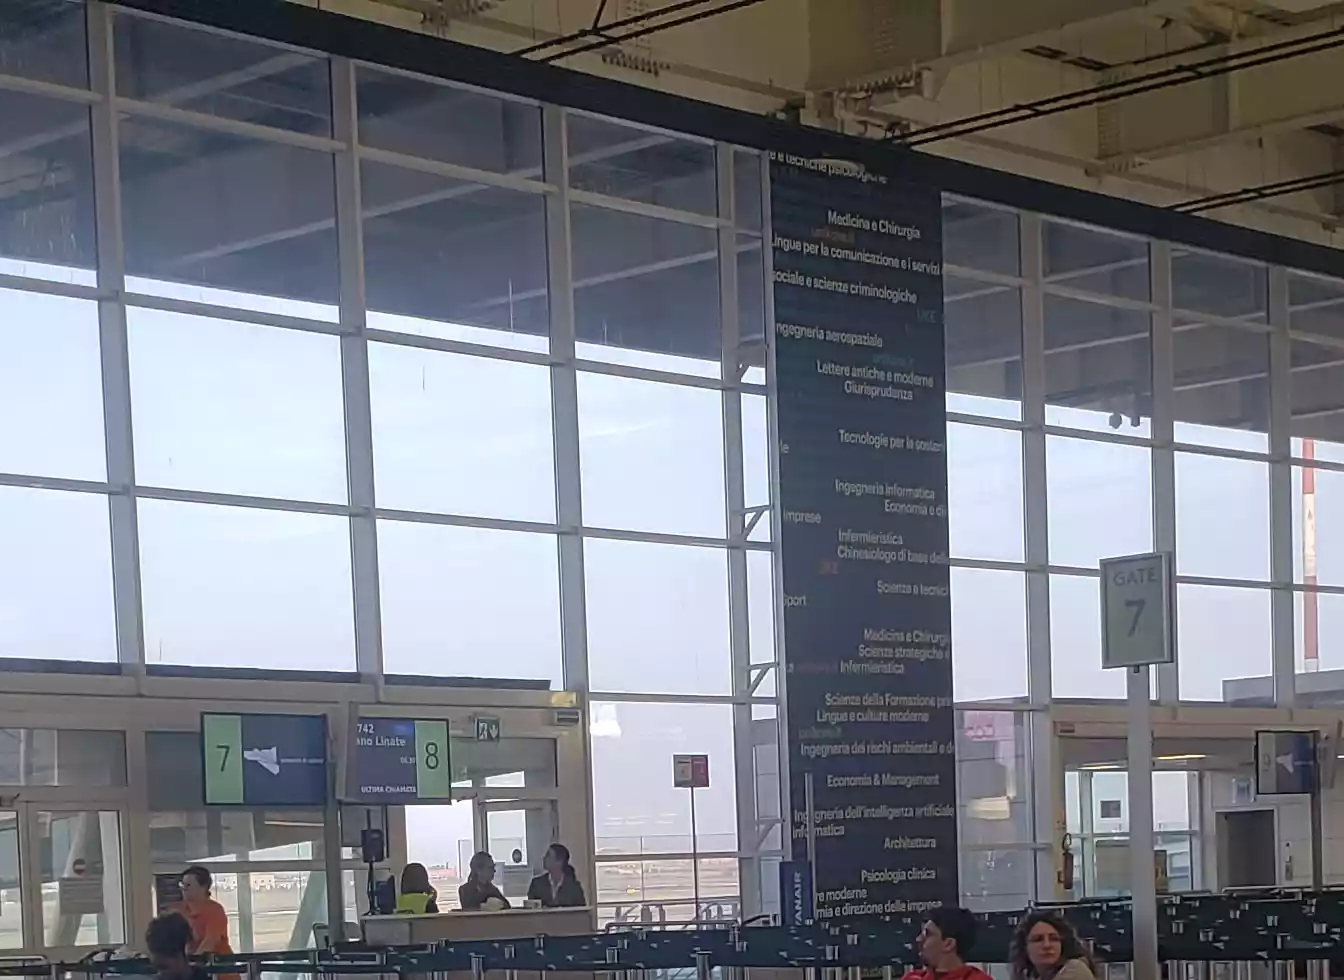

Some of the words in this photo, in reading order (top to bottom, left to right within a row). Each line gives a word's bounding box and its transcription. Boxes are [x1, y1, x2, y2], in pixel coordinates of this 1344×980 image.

[828, 210, 870, 231] Medicina
[878, 219, 921, 241] Chirurgia
[803, 243, 820, 257] per
[820, 242, 830, 257] la
[830, 247, 900, 269] comunicazione
[813, 276, 848, 295] scienze
[849, 280, 918, 304] criminologiche
[776, 322, 824, 341] ngegneria
[825, 326, 883, 348] aerospaziale
[816, 359, 850, 378] Lettere
[851, 363, 885, 381] antiche
[893, 369, 933, 388] moderne
[844, 380, 913, 401] Giurisprudenza
[838, 428, 889, 450] Tecnologie
[835, 478, 884, 497] Ingegneria
[884, 500, 928, 517] Economia
[838, 529, 903, 546] Infermieristica
[1113, 567, 1157, 587] GATE
[1124, 598, 1146, 637] 7
[864, 628, 906, 643] Medicina
[375, 735, 406, 748] Linate
[800, 742, 851, 758] Ingegneria
[216, 743, 231, 772] 7
[425, 742, 439, 770] 8
[827, 774, 872, 788] Economia
[793, 823, 845, 840] infomatica
[861, 868, 906, 884] Psicologia
[907, 866, 936, 881] clinica
[825, 887, 867, 901] moderne
[841, 901, 884, 915] direzione
